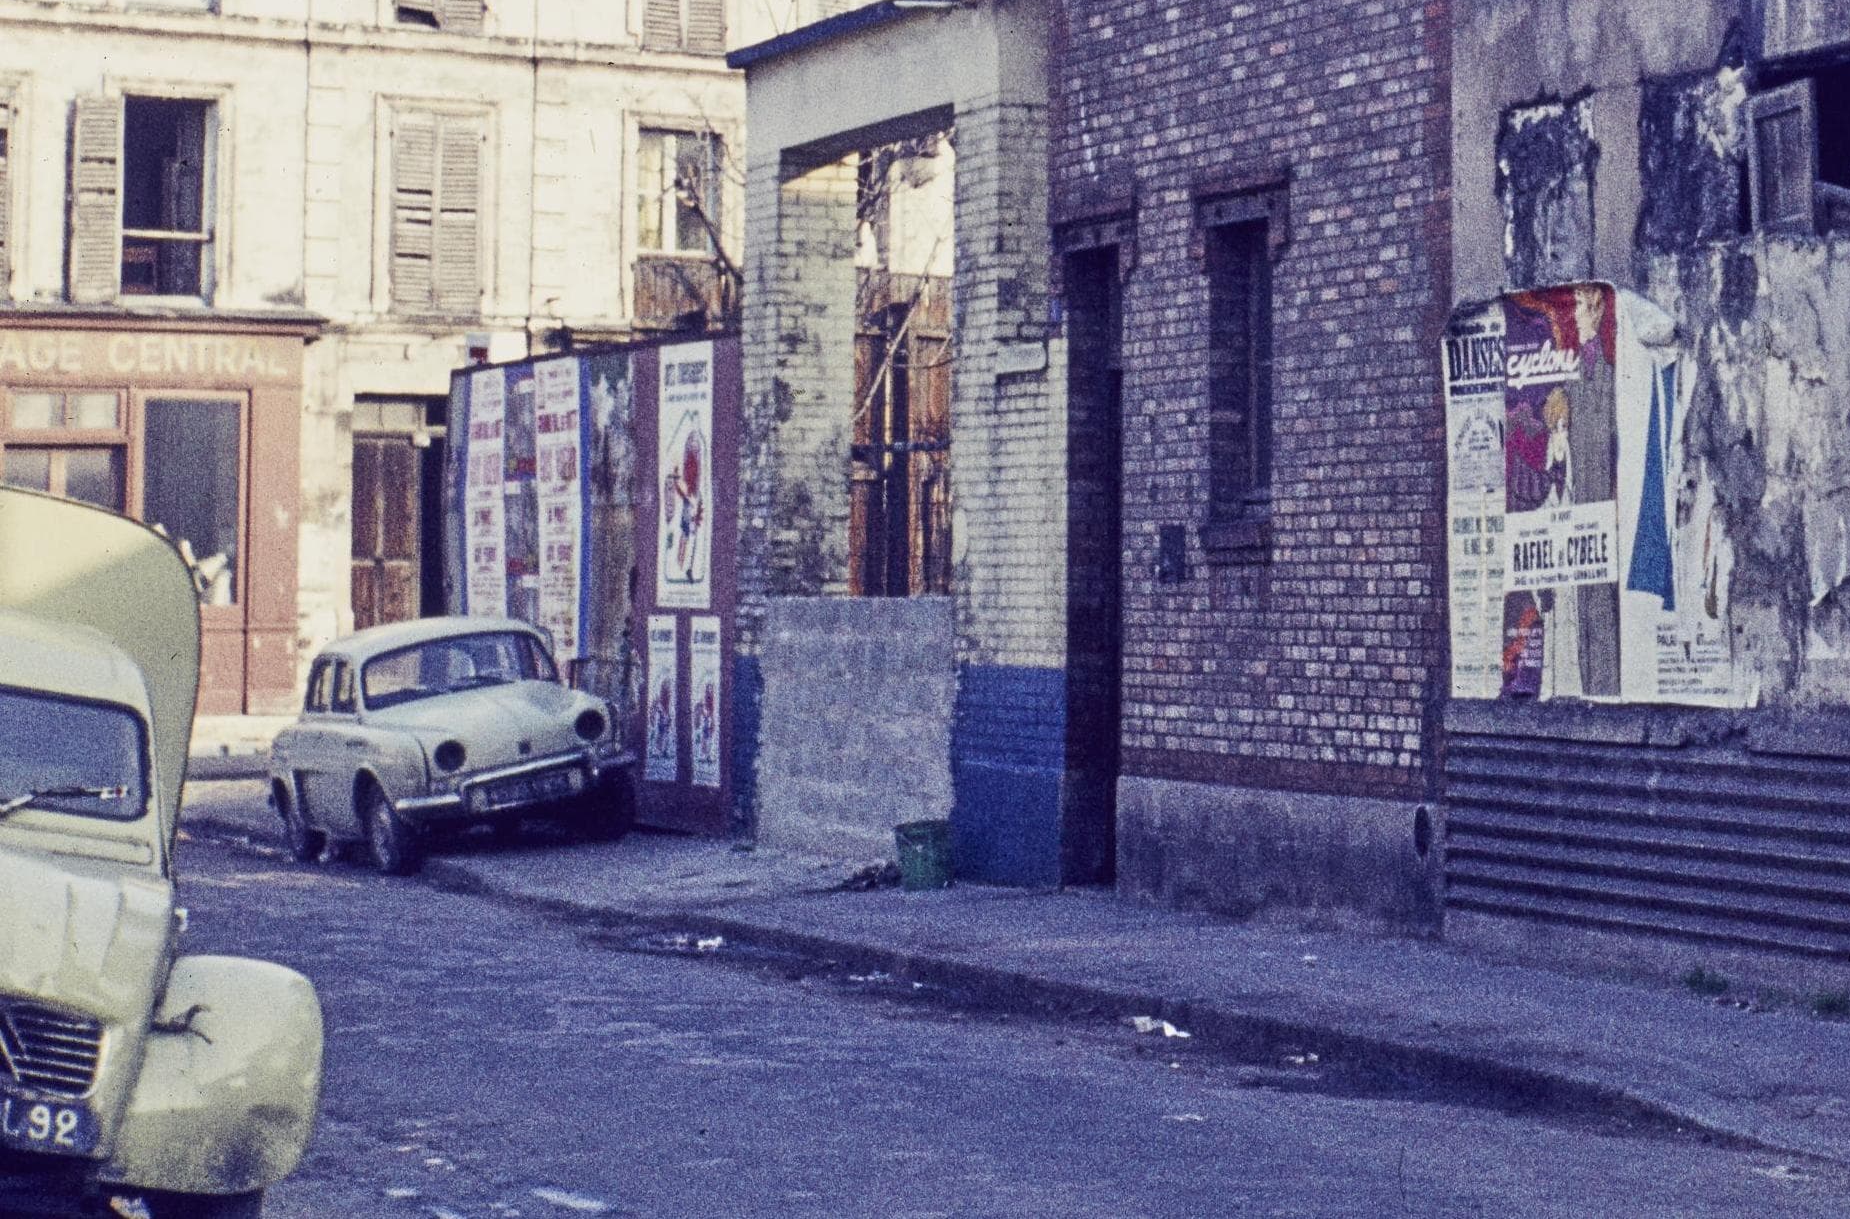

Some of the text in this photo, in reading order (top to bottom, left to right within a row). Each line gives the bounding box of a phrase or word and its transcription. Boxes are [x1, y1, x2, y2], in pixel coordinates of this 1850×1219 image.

[107, 335, 288, 376] CENTRAL
[1506, 339, 1580, 384] cyclone
[1513, 539, 1555, 573] RAFAEL
[1567, 532, 1608, 567] CYBELE
[28, 1104, 78, 1147] 92
